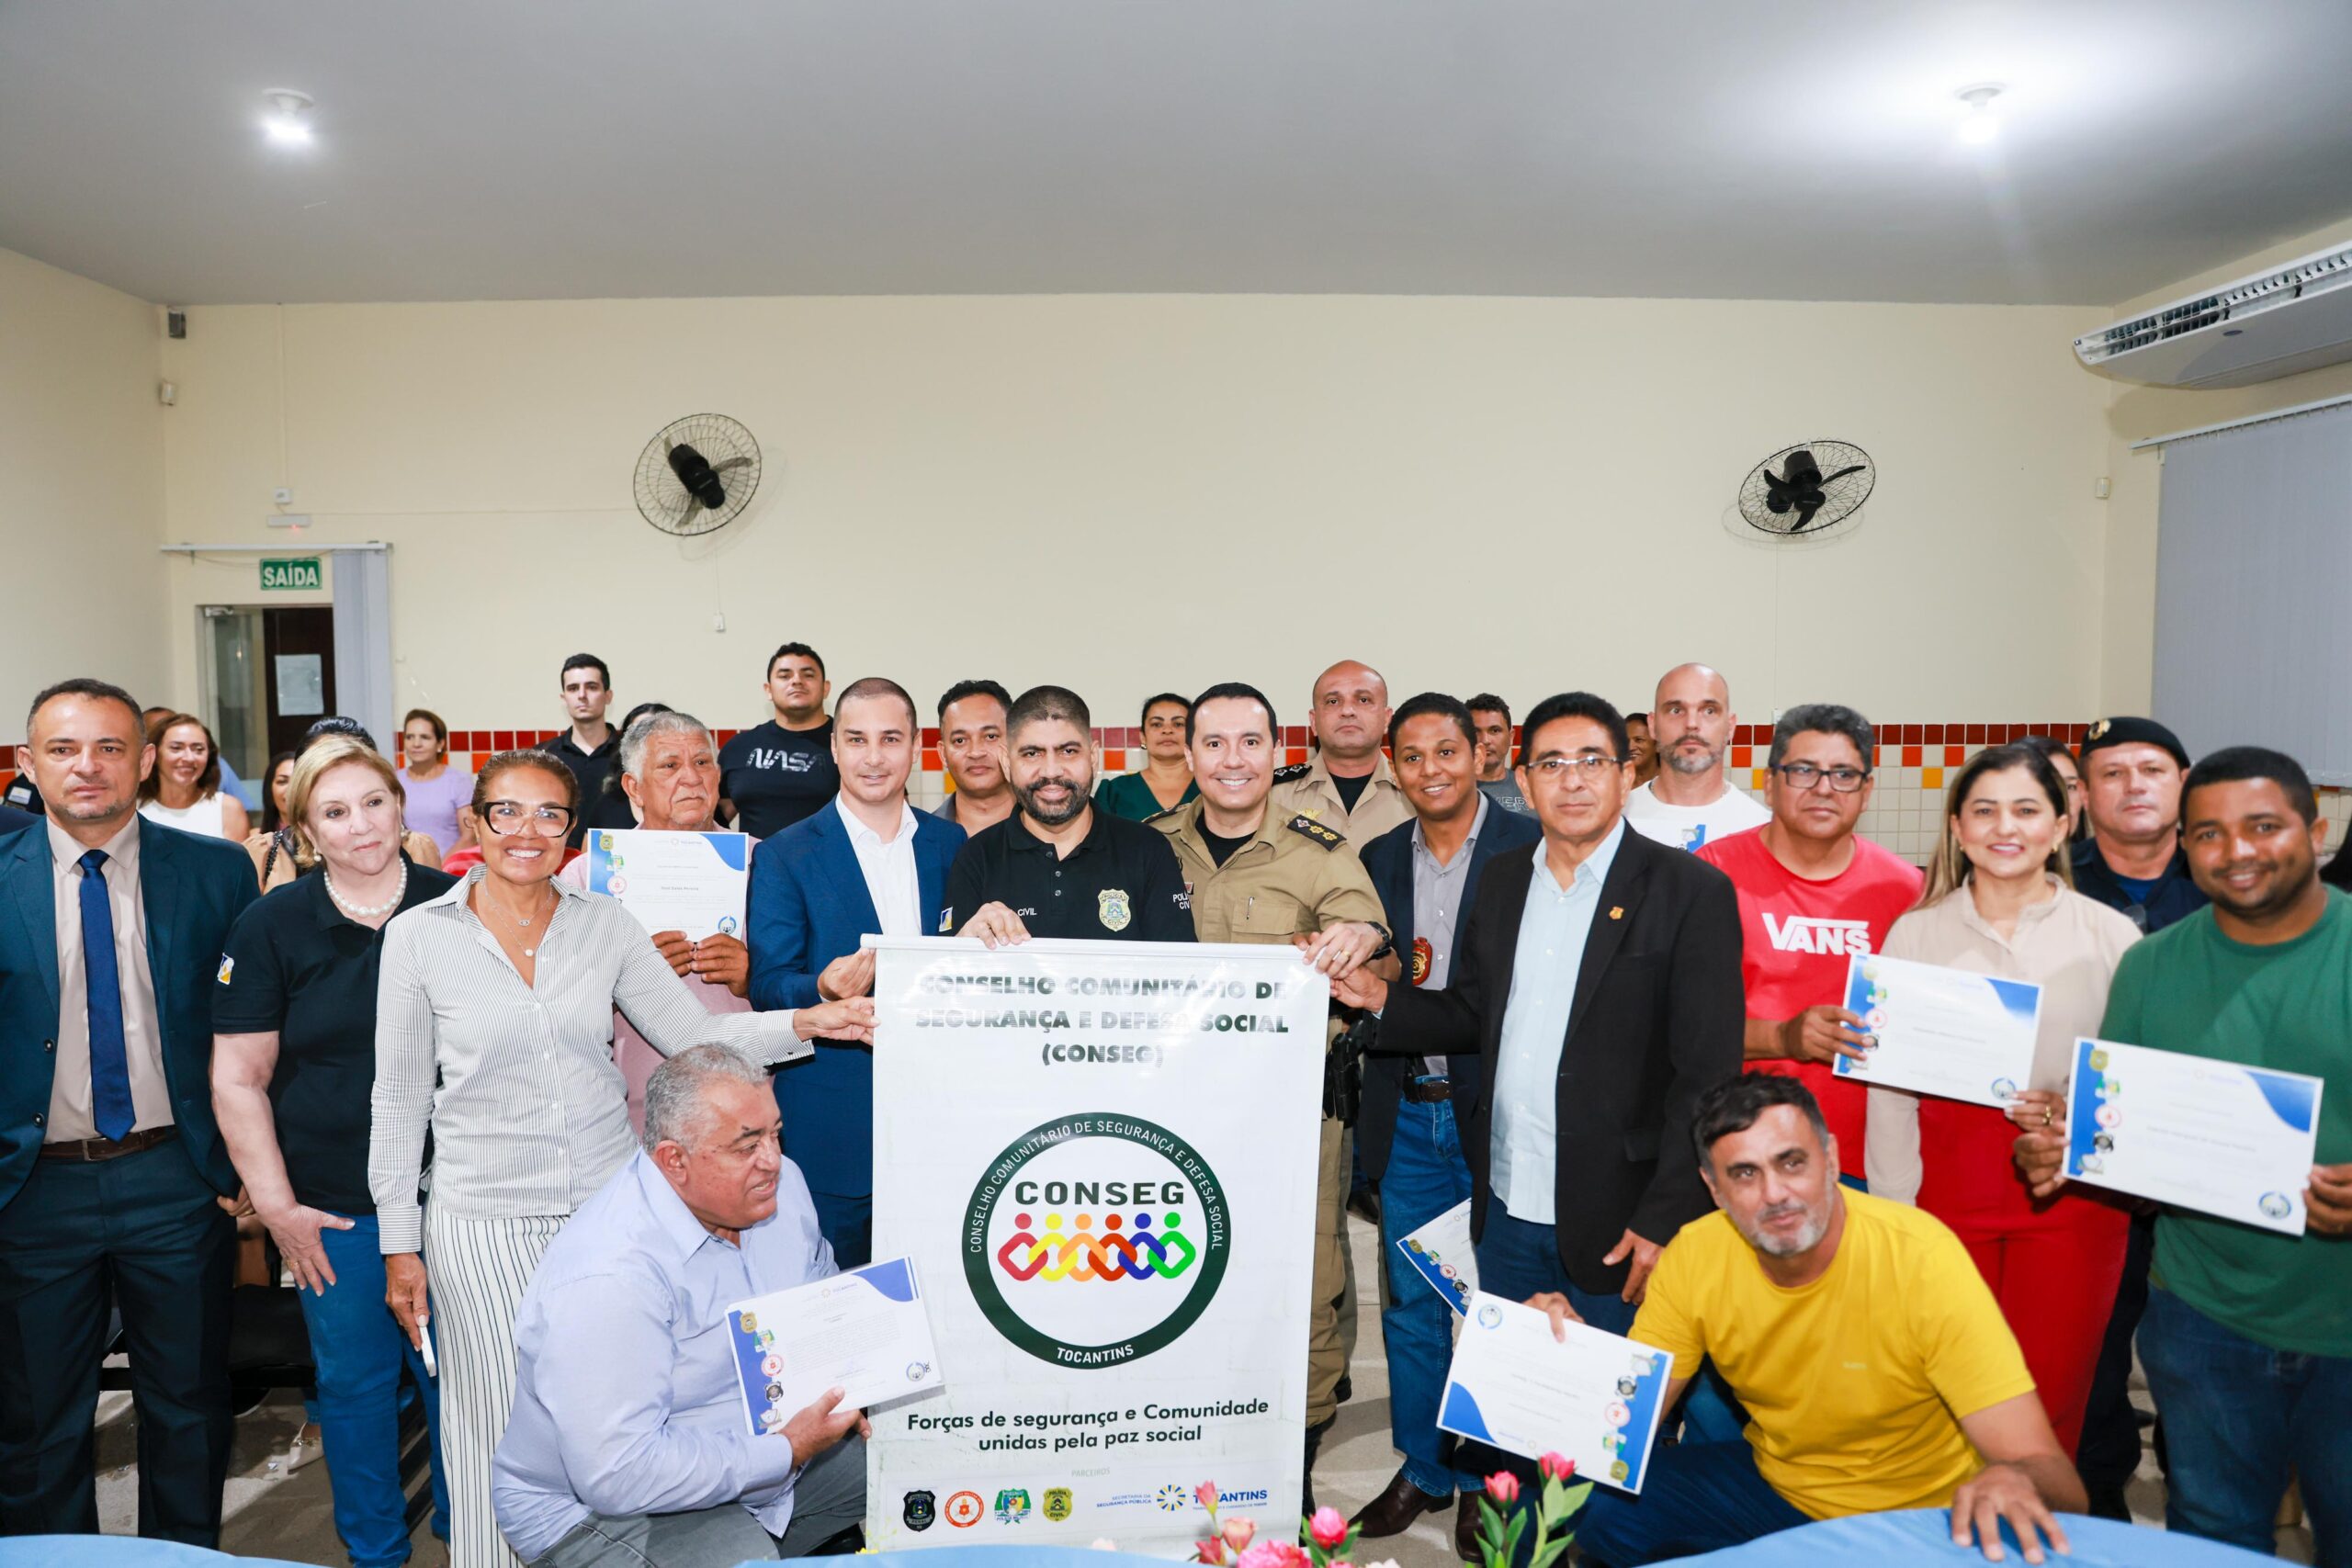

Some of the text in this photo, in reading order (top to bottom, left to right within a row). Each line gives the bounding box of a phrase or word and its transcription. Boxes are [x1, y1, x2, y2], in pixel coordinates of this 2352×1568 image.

[264, 562, 318, 586] SAÍDA
[1017, 907, 1037, 917] CIVIL
[1761, 912, 1871, 954] VANS
[1255, 981, 1287, 999] DE
[916, 1010, 1070, 1032] SEGURANÇA
[1079, 1011, 1091, 1029] E
[1200, 1014, 1289, 1032] SOCIAL
[1042, 1043, 1163, 1068] (CONSEG)
[970, 1121, 1224, 1253] CONSELHO COMUNITÁRIO DE SEGURANÇA E DEFESA SOCIAL
[1015, 1181, 1184, 1206] CONSEG
[1057, 1344, 1135, 1364] TOCANTINS
[908, 1398, 1269, 1433] Forças de segurança e Comunidade
[978, 1426, 1202, 1452] unidas pela paz social
[1193, 1490, 1268, 1504] TANTINS
